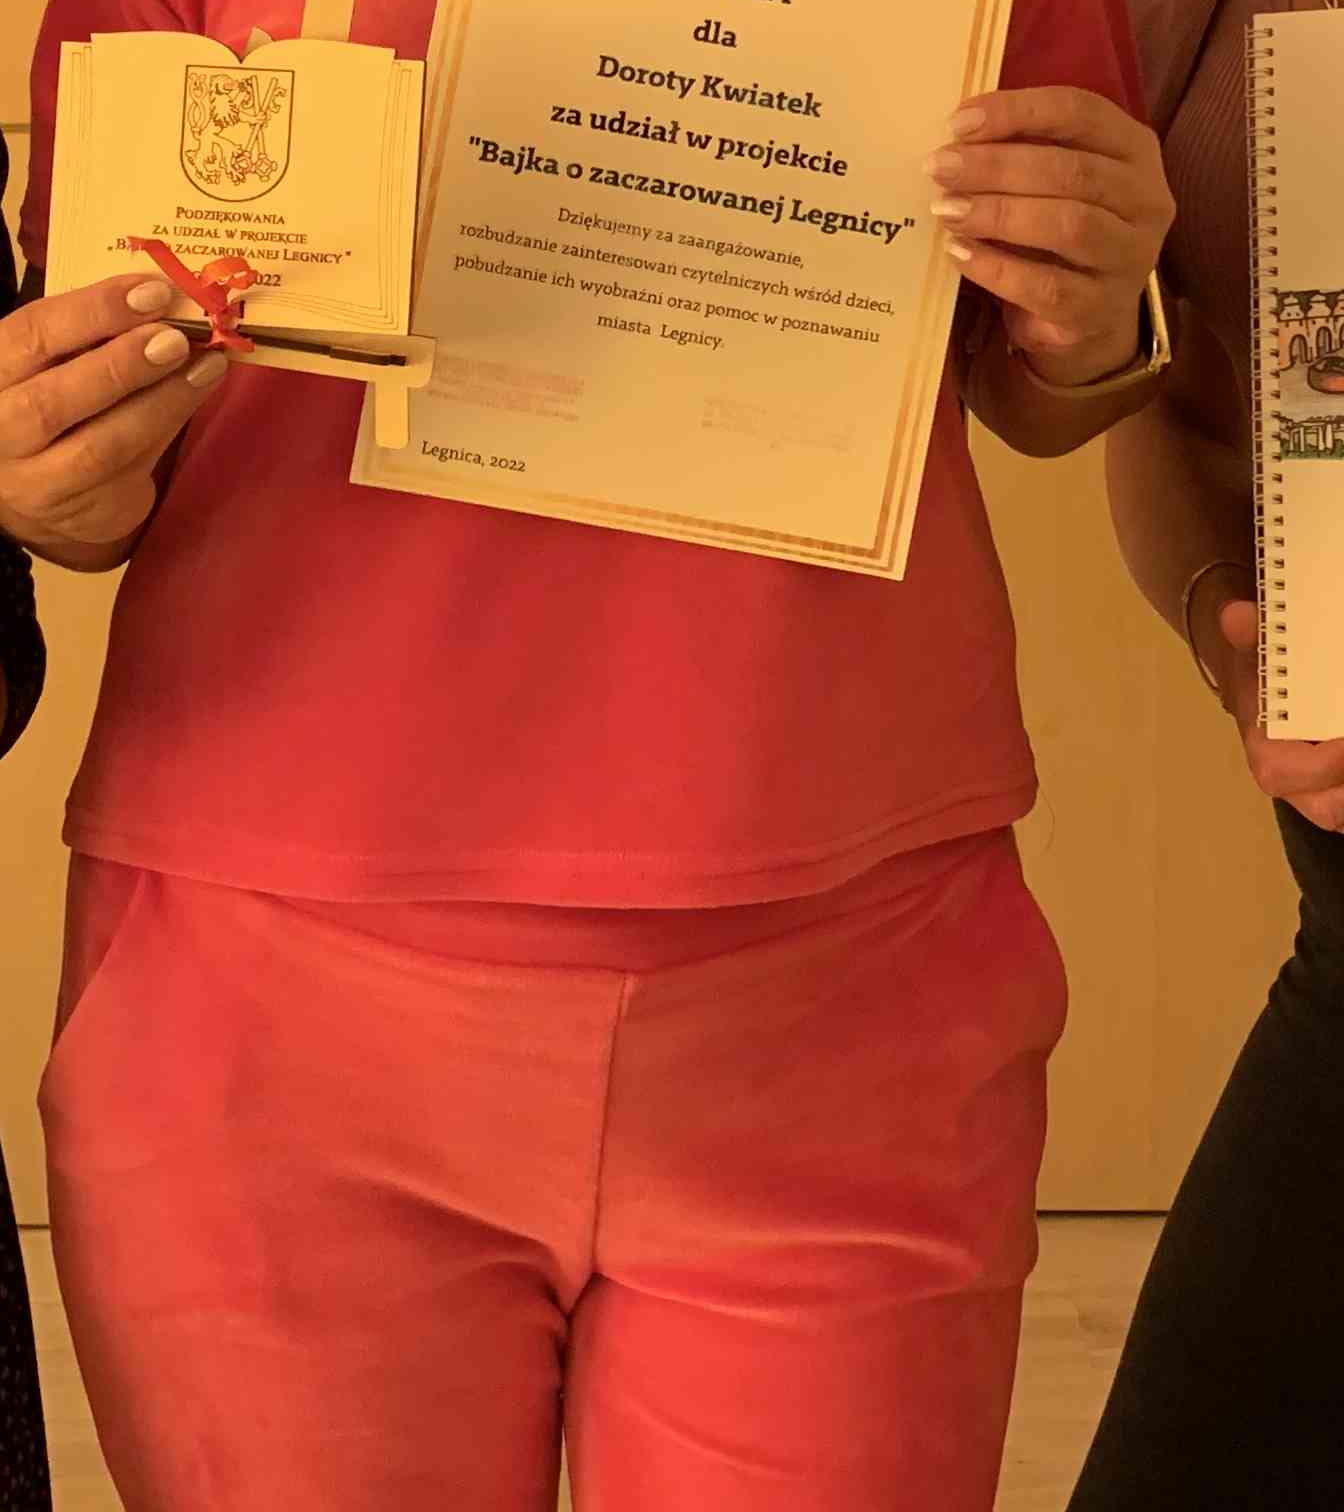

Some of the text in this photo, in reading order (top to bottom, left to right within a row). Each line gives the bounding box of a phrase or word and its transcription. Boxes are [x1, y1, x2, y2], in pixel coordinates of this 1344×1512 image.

[693, 20, 737, 48] dla
[596, 56, 822, 118] Doroty Kwiatek
[551, 105, 847, 177] za udział w projekcie
[469, 137, 915, 244] "Bajka o zaczarowanej Legnicy"
[152, 225, 308, 245] ZA UDZIAŁ W PROJEKCIE
[175, 243, 279, 260] ZACZAROWANEJ
[558, 208, 804, 269] Dziękujemy za zaangażowanie,
[454, 254, 880, 343] pobudzanie ich wyobraźni oraz pomoc w poznawaniu
[460, 223, 895, 314] rozbudzanie zainteresowań czytelniczych wśród dzieci,
[597, 313, 724, 349] miasta Legnicy.
[421, 440, 526, 472] Legnica, 2022
